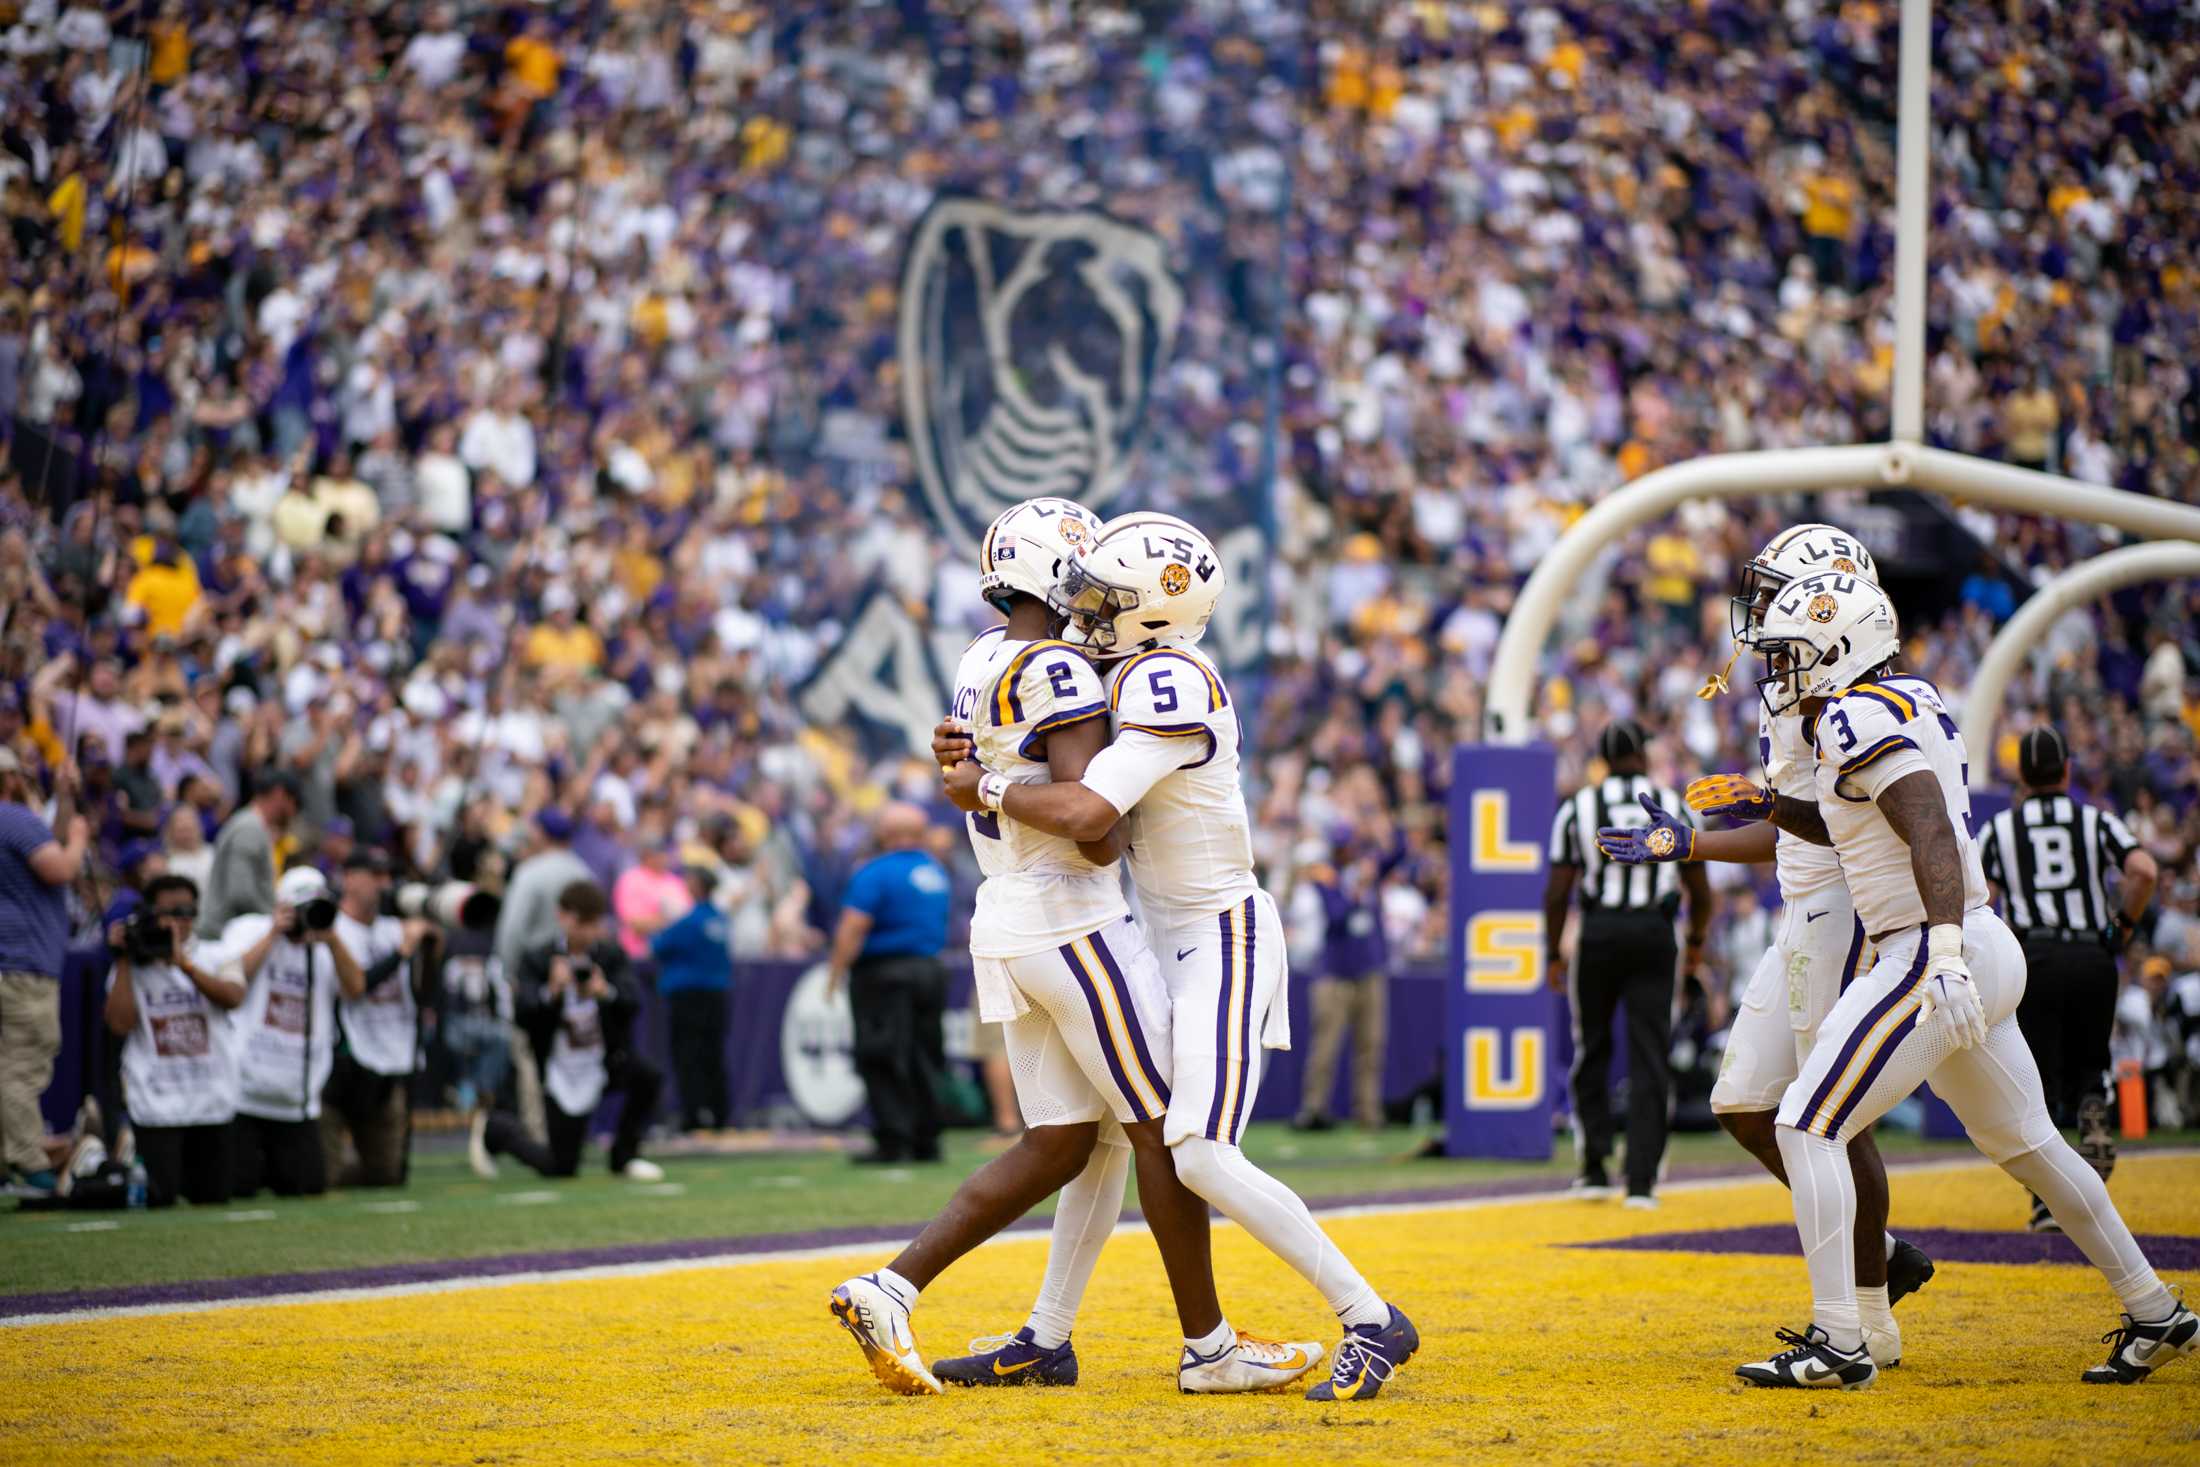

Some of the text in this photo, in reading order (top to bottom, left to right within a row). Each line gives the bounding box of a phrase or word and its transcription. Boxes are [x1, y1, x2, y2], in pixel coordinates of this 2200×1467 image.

[1143, 536, 1216, 583] LSU
[1803, 536, 1870, 570] LSU
[1777, 575, 1856, 617] LSU
[1879, 604, 1887, 616] 3
[1046, 661, 1078, 698] 2
[1148, 669, 1179, 713] 5
[1829, 709, 1858, 753] 3
[2028, 825, 2077, 890] B
[1463, 789, 1547, 1112] LSU
